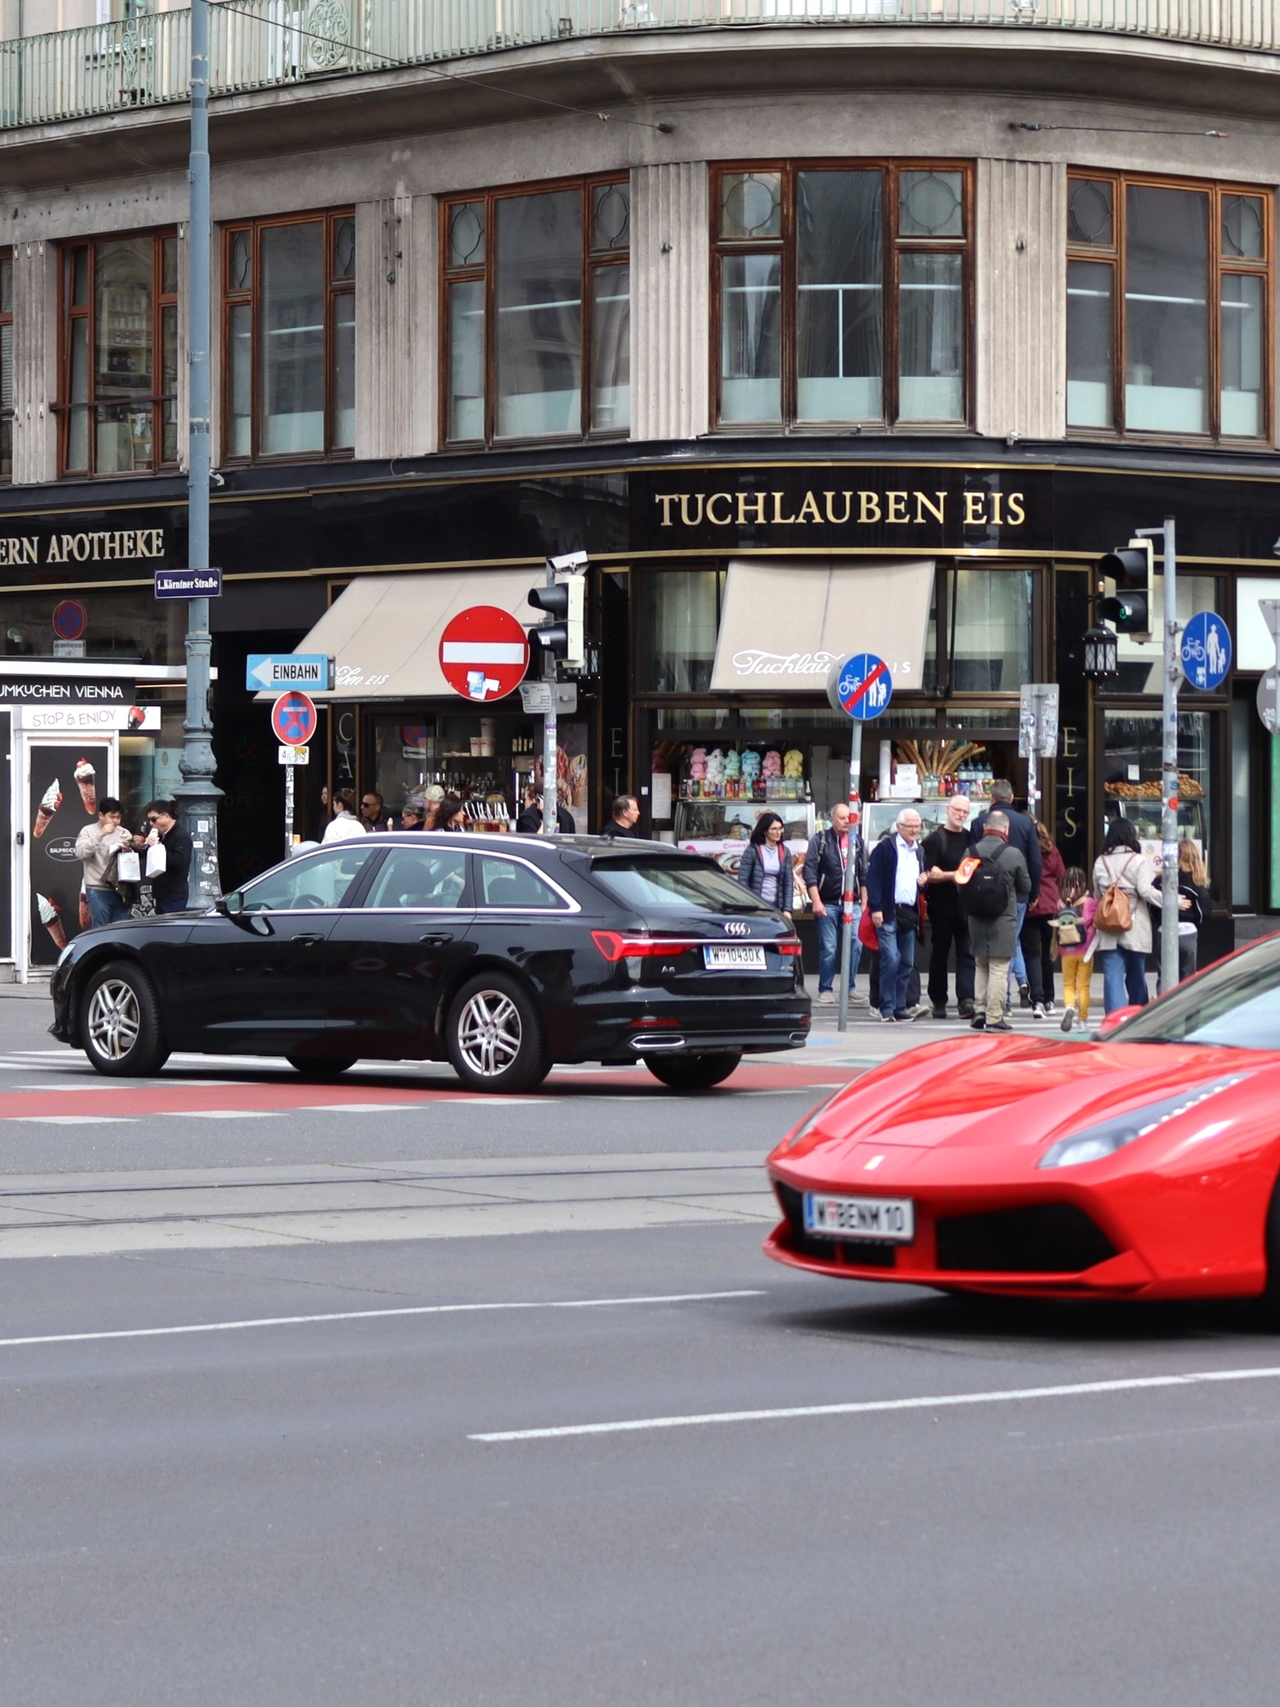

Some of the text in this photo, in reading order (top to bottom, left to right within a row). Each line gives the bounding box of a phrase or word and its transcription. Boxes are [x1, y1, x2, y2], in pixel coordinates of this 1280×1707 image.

[655, 491, 1026, 526] TUCHLAUBEN EIS
[46, 528, 165, 563] APOTHEKE
[163, 578, 194, 590] Kärntner
[194, 576, 218, 589] Straße
[273, 664, 319, 680] EINBAHN
[364, 674, 390, 685] EIS
[75, 685, 124, 698] VIENNA
[67, 712, 76, 726] &
[79, 708, 117, 726] ENJOY
